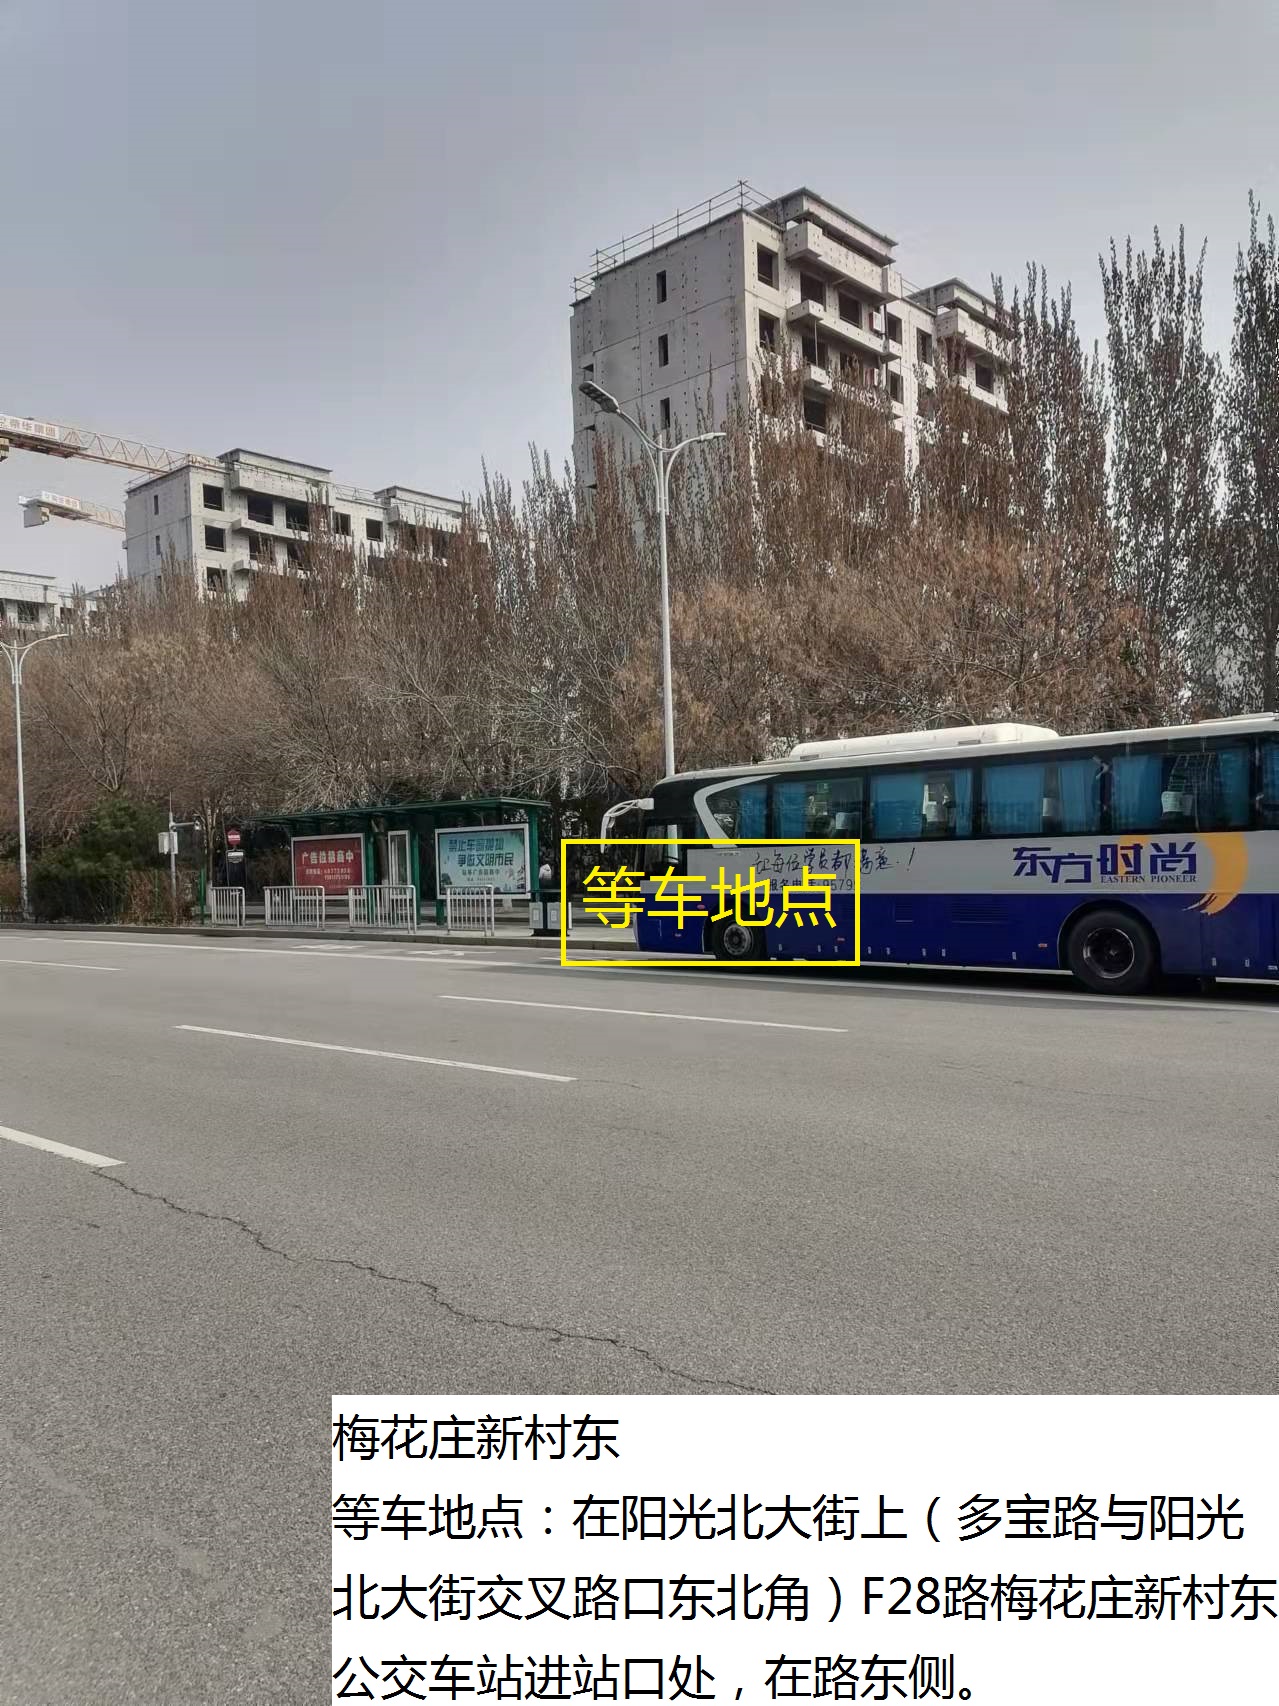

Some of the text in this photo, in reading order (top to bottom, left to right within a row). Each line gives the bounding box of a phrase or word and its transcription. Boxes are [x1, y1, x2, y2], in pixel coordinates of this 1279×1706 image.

[457, 852, 515, 867] 争做文明市民
[1013, 841, 1197, 884] 东方时尚
[1100, 874, 1197, 884] EASTERN PIONEER
